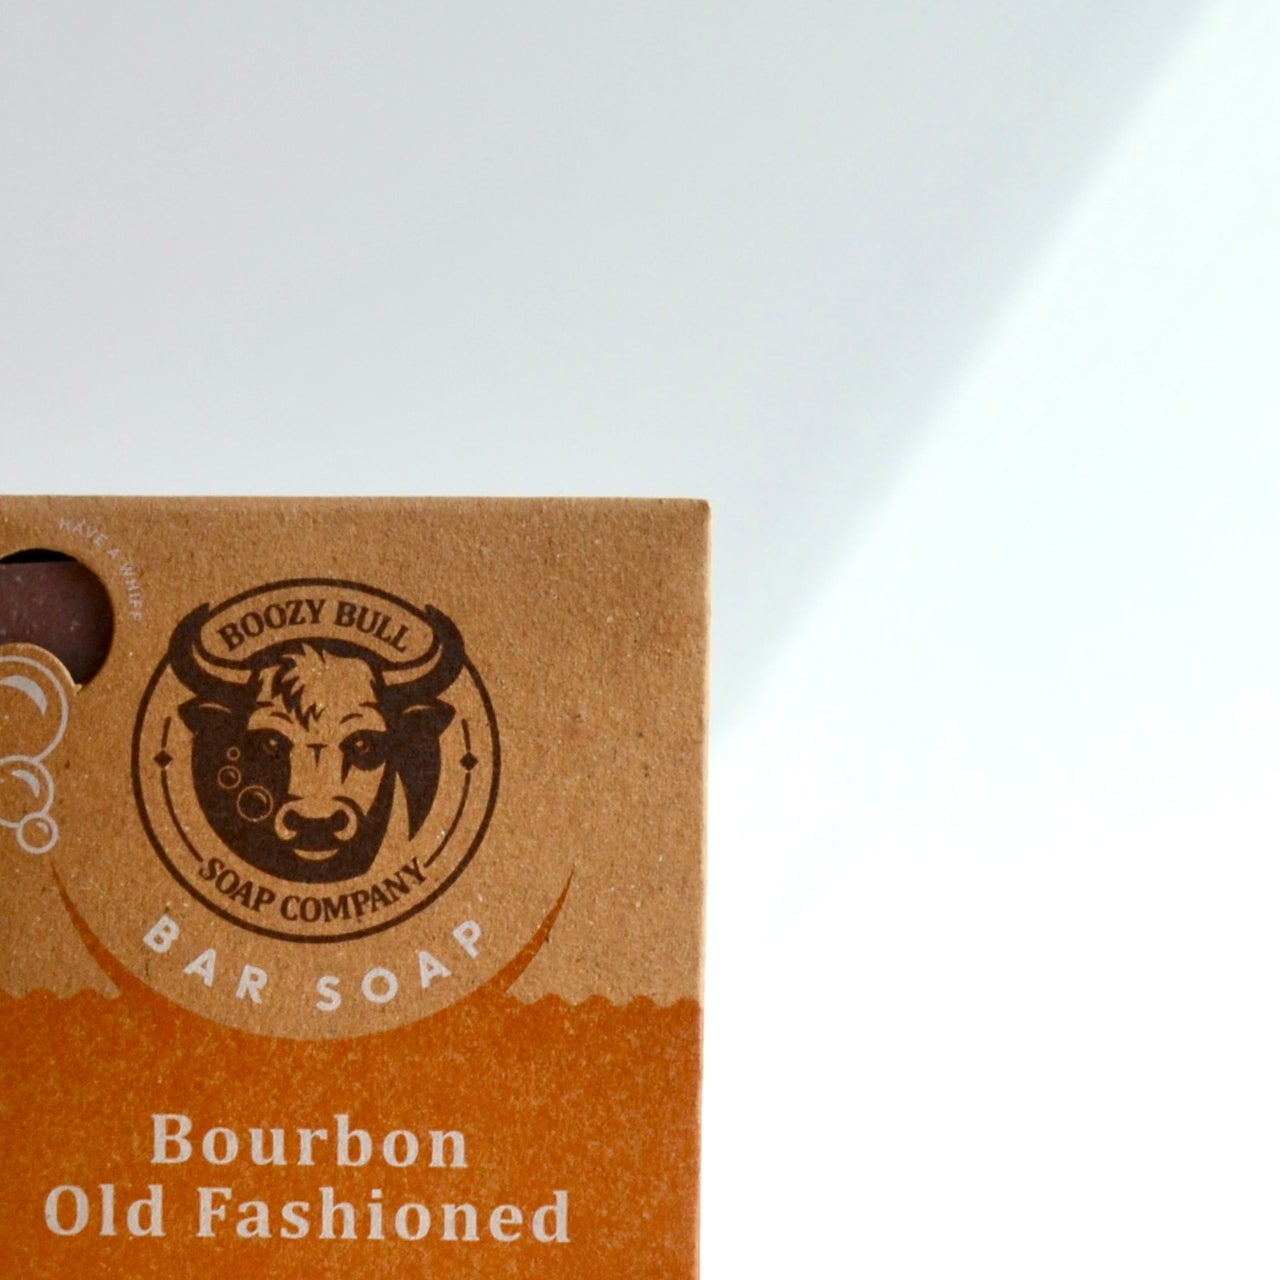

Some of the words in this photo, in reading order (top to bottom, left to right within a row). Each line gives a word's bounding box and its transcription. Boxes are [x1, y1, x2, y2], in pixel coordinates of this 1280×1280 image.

[216, 597, 328, 652] BOOZY
[333, 599, 410, 653] BULL
[198, 857, 275, 913] SOAP
[279, 856, 427, 924] COMPANY
[143, 915, 269, 1005] BAR
[316, 920, 483, 1012] SOAP
[150, 1113, 468, 1168] Bourbon
[44, 1183, 166, 1237] Old
[195, 1186, 571, 1243] Fashioned
